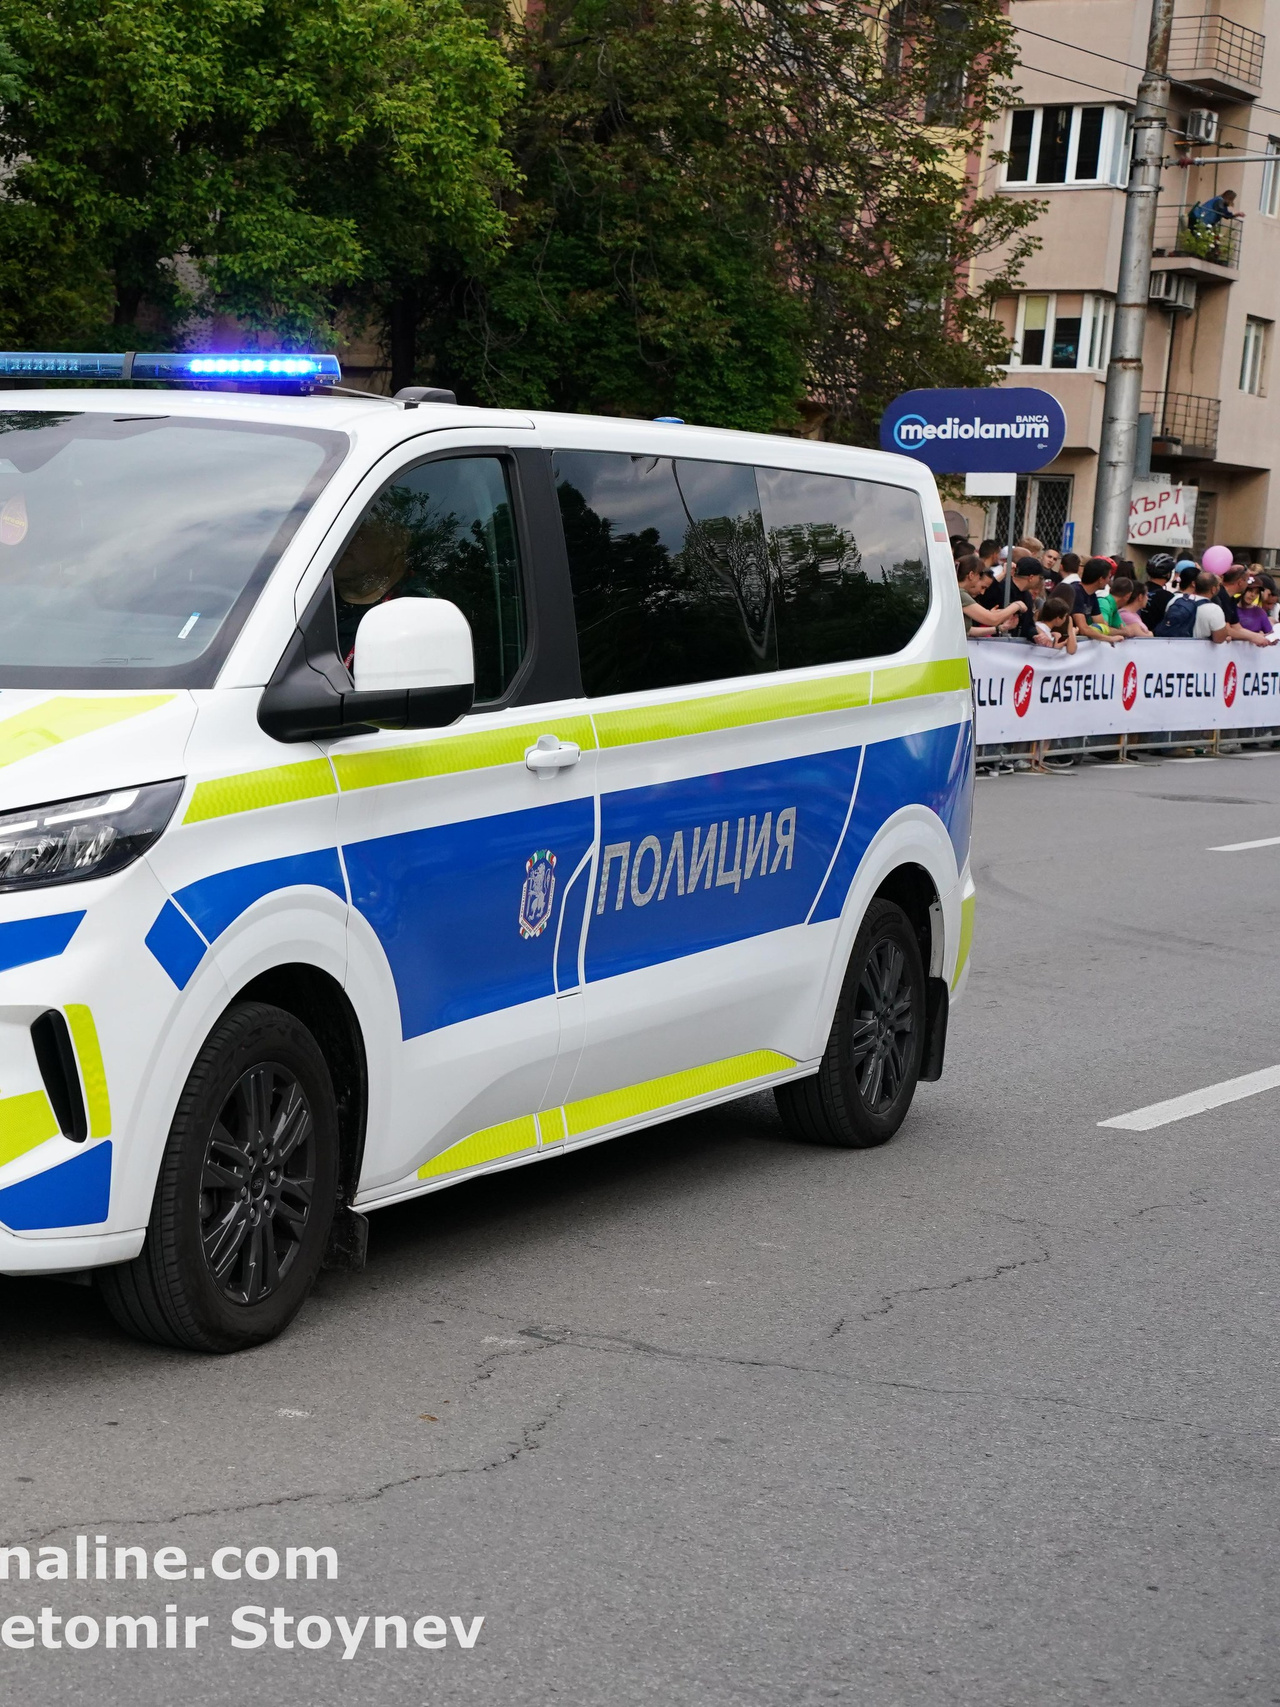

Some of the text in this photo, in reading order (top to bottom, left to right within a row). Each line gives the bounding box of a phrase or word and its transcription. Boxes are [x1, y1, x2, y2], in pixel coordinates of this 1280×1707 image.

[900, 417, 1049, 440] mediolanum
[1015, 415, 1049, 423] BANCA
[1040, 674, 1115, 703] CASTELLI
[1143, 672, 1216, 699] CASTELLI
[1242, 672, 1280, 696] CAST
[596, 806, 797, 915] ПОЛИЦИЯ
